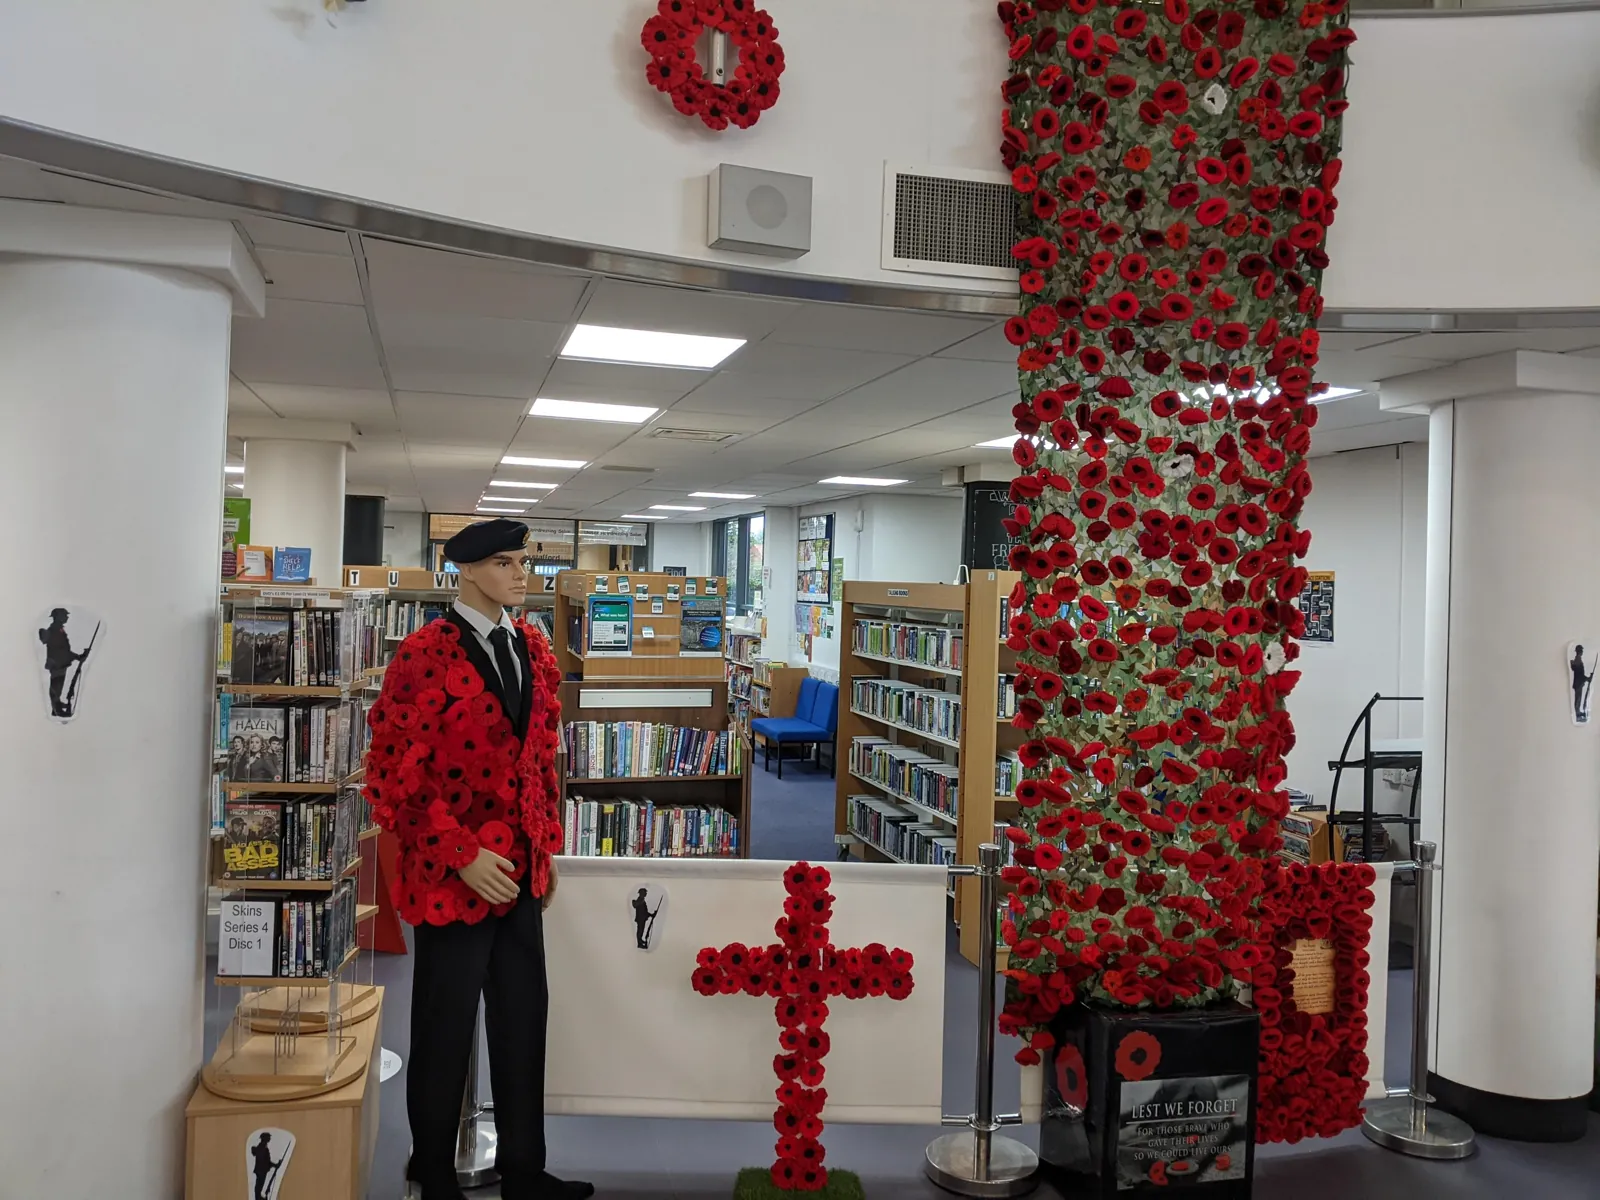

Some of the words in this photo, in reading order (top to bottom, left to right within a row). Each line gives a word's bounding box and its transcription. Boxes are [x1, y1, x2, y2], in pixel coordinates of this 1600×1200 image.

[351, 571, 359, 585] T
[389, 572, 398, 586] U
[435, 573, 445, 588] V
[545, 576, 555, 591] Z
[236, 718, 278, 735] HAVEN
[223, 843, 279, 864] BAD
[226, 857, 279, 872] ASSES
[231, 904, 263, 917] Skins
[224, 920, 259, 933] Series
[261, 921, 269, 933] 4
[228, 937, 253, 950] Disc
[256, 938, 262, 950] 1
[1131, 1103, 1160, 1119] LEST
[1164, 1101, 1183, 1117] WE
[1188, 1098, 1238, 1115] FORGET
[1137, 1127, 1154, 1137] FOR
[1155, 1125, 1181, 1135] THOSE
[1185, 1123, 1208, 1133] BRAVE
[1210, 1121, 1230, 1131] WHO
[1148, 1138, 1167, 1148] GAVE
[1171, 1136, 1195, 1146] THEIR
[1197, 1134, 1218, 1144] LIVES
[1134, 1151, 1144, 1161] SO
[1147, 1150, 1158, 1160] WE
[1160, 1148, 1188, 1158] COULD
[1191, 1146, 1207, 1157] LIVE
[1210, 1144, 1232, 1154] OURS
